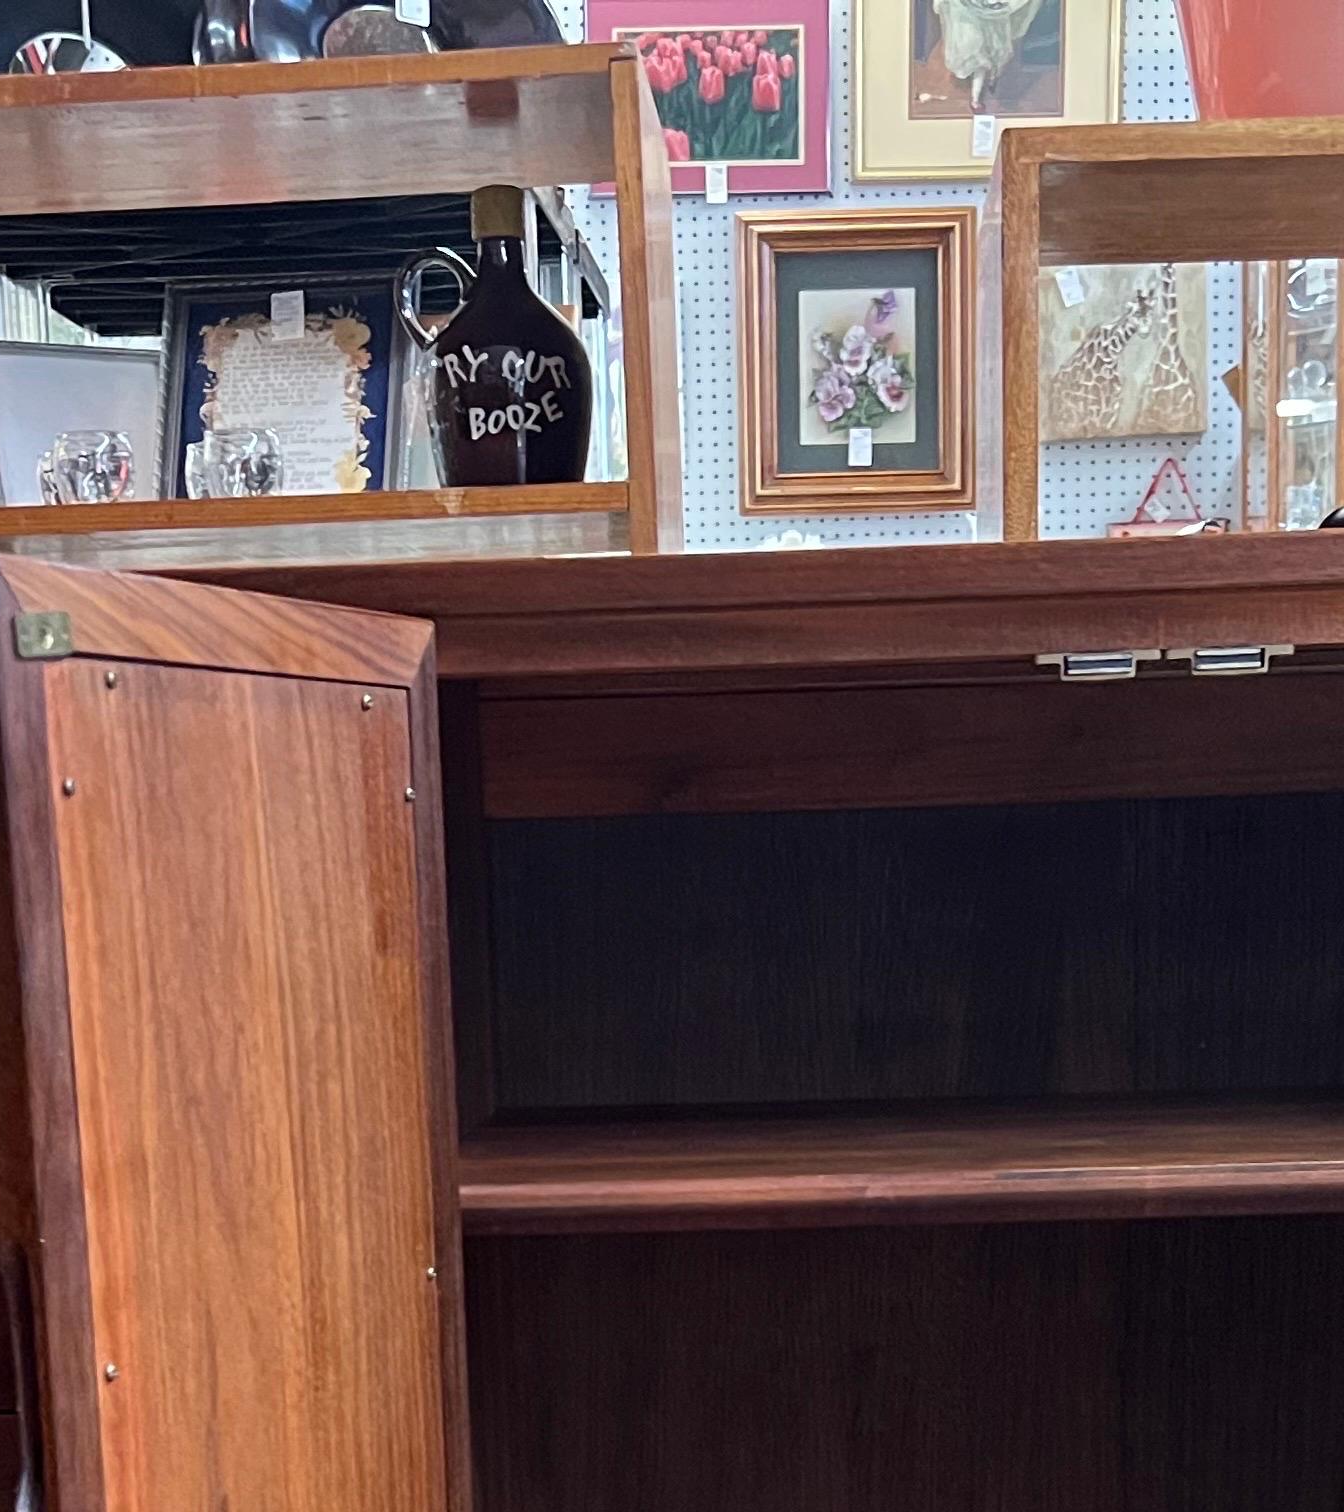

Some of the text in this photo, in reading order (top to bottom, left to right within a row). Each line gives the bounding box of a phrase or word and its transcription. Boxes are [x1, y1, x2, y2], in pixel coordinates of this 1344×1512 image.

[443, 344, 572, 389] RY OUR
[468, 390, 564, 440] BOOZE
